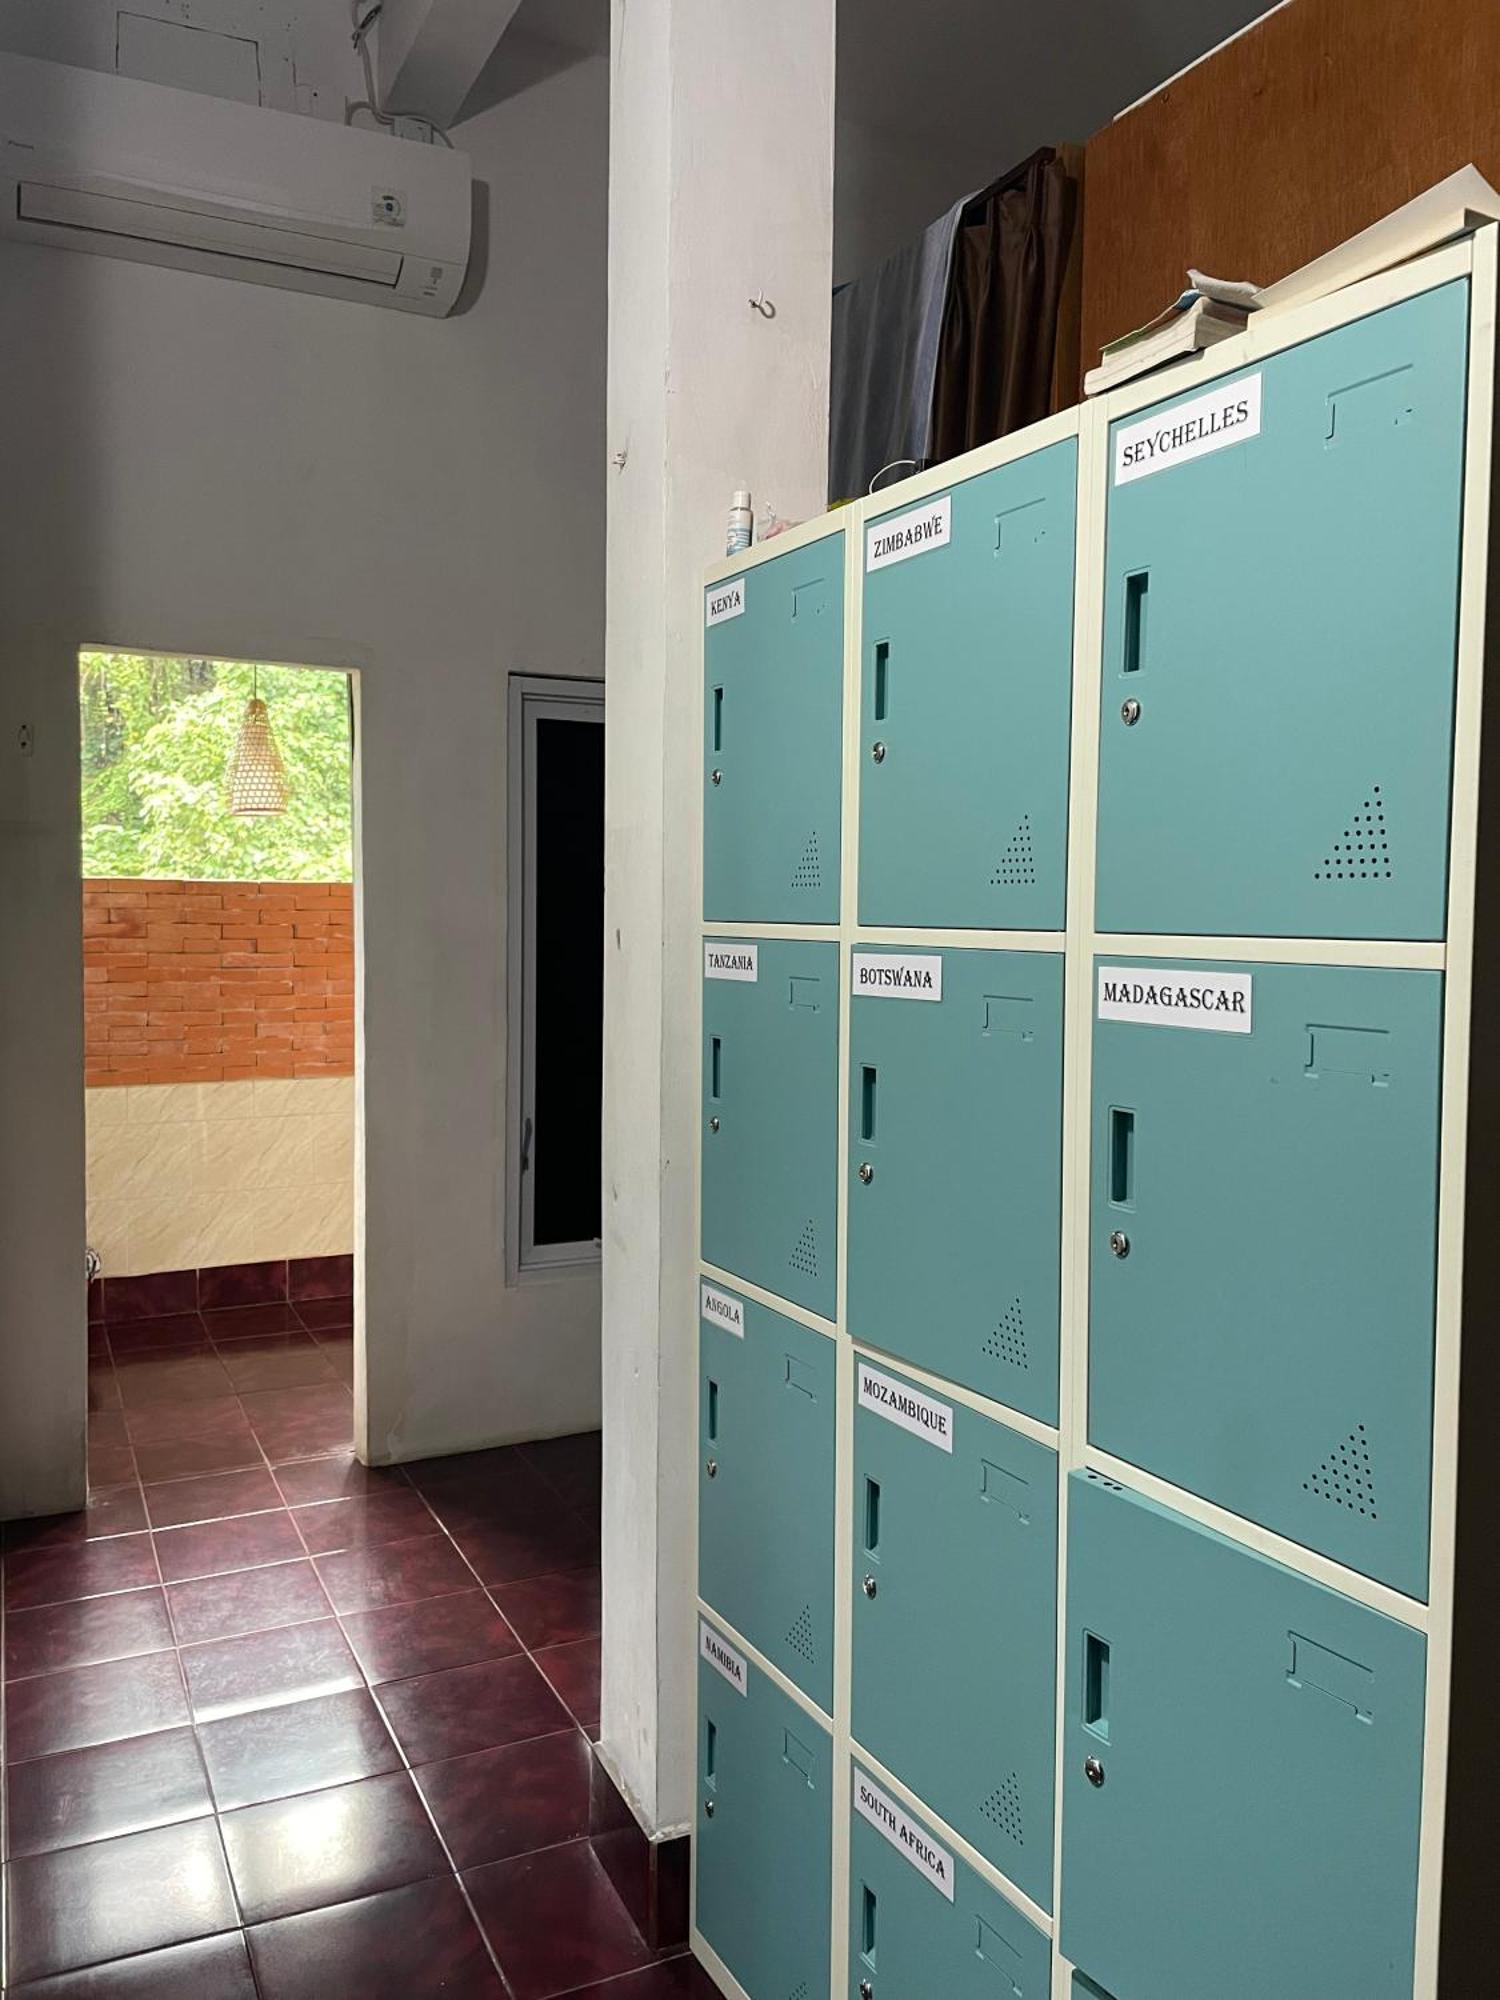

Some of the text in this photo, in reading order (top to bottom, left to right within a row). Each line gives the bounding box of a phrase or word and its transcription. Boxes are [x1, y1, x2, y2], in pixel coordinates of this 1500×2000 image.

[1122, 401, 1249, 467] SEYCHELLES
[873, 514, 942, 558] ZIMBABWE
[711, 591, 741, 616] KENYA
[708, 954, 754, 971] TANZANIA
[860, 966, 933, 989] BOTSWANA
[1103, 982, 1246, 1013] MADAGASCAR
[705, 1296, 741, 1325] ANGOLA
[863, 1377, 947, 1436] MOZAMBIQUE
[705, 1636, 742, 1682] NAMIBIA
[860, 1785, 946, 1880] SOUTH AFRICA
